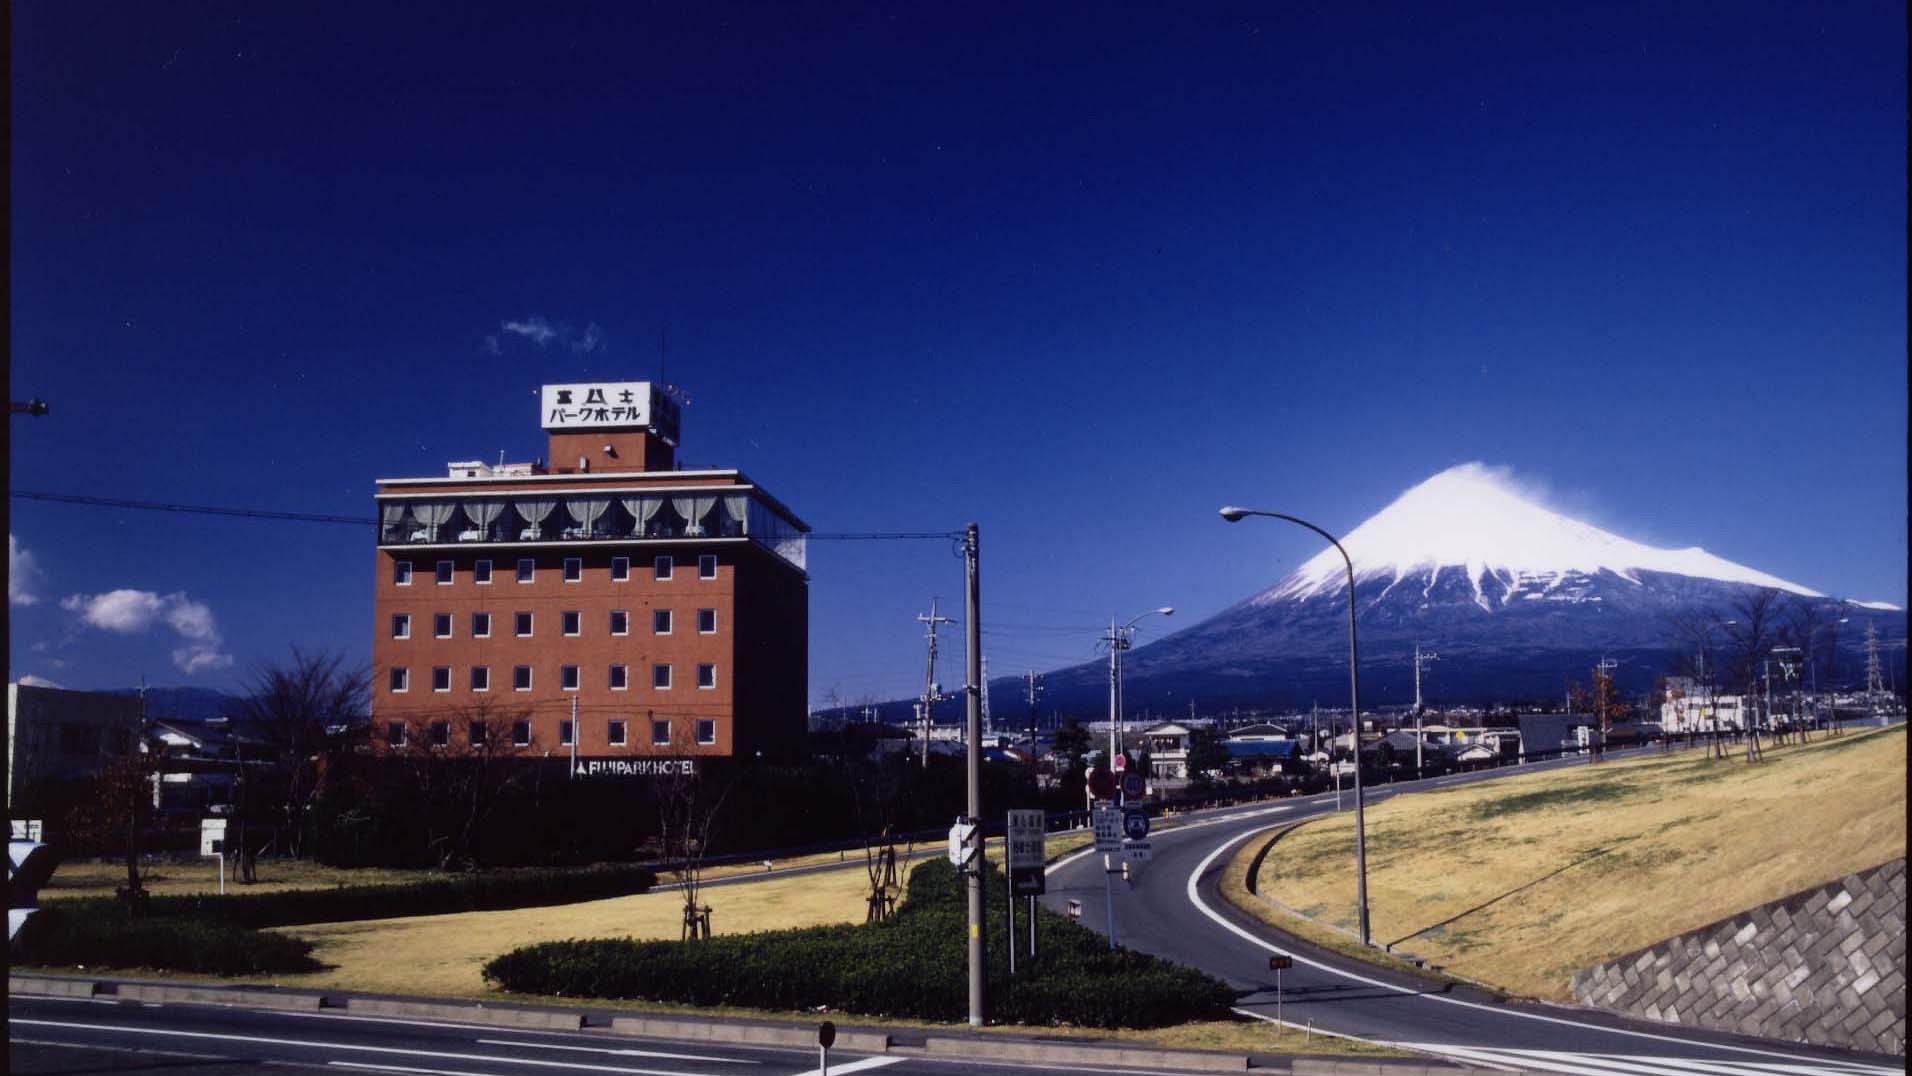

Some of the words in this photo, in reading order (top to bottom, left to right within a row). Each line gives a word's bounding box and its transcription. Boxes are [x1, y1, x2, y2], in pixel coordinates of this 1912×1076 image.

[550, 406, 641, 423] パークホテル
[617, 760, 652, 775] PARK
[653, 760, 696, 775] HOTEL
